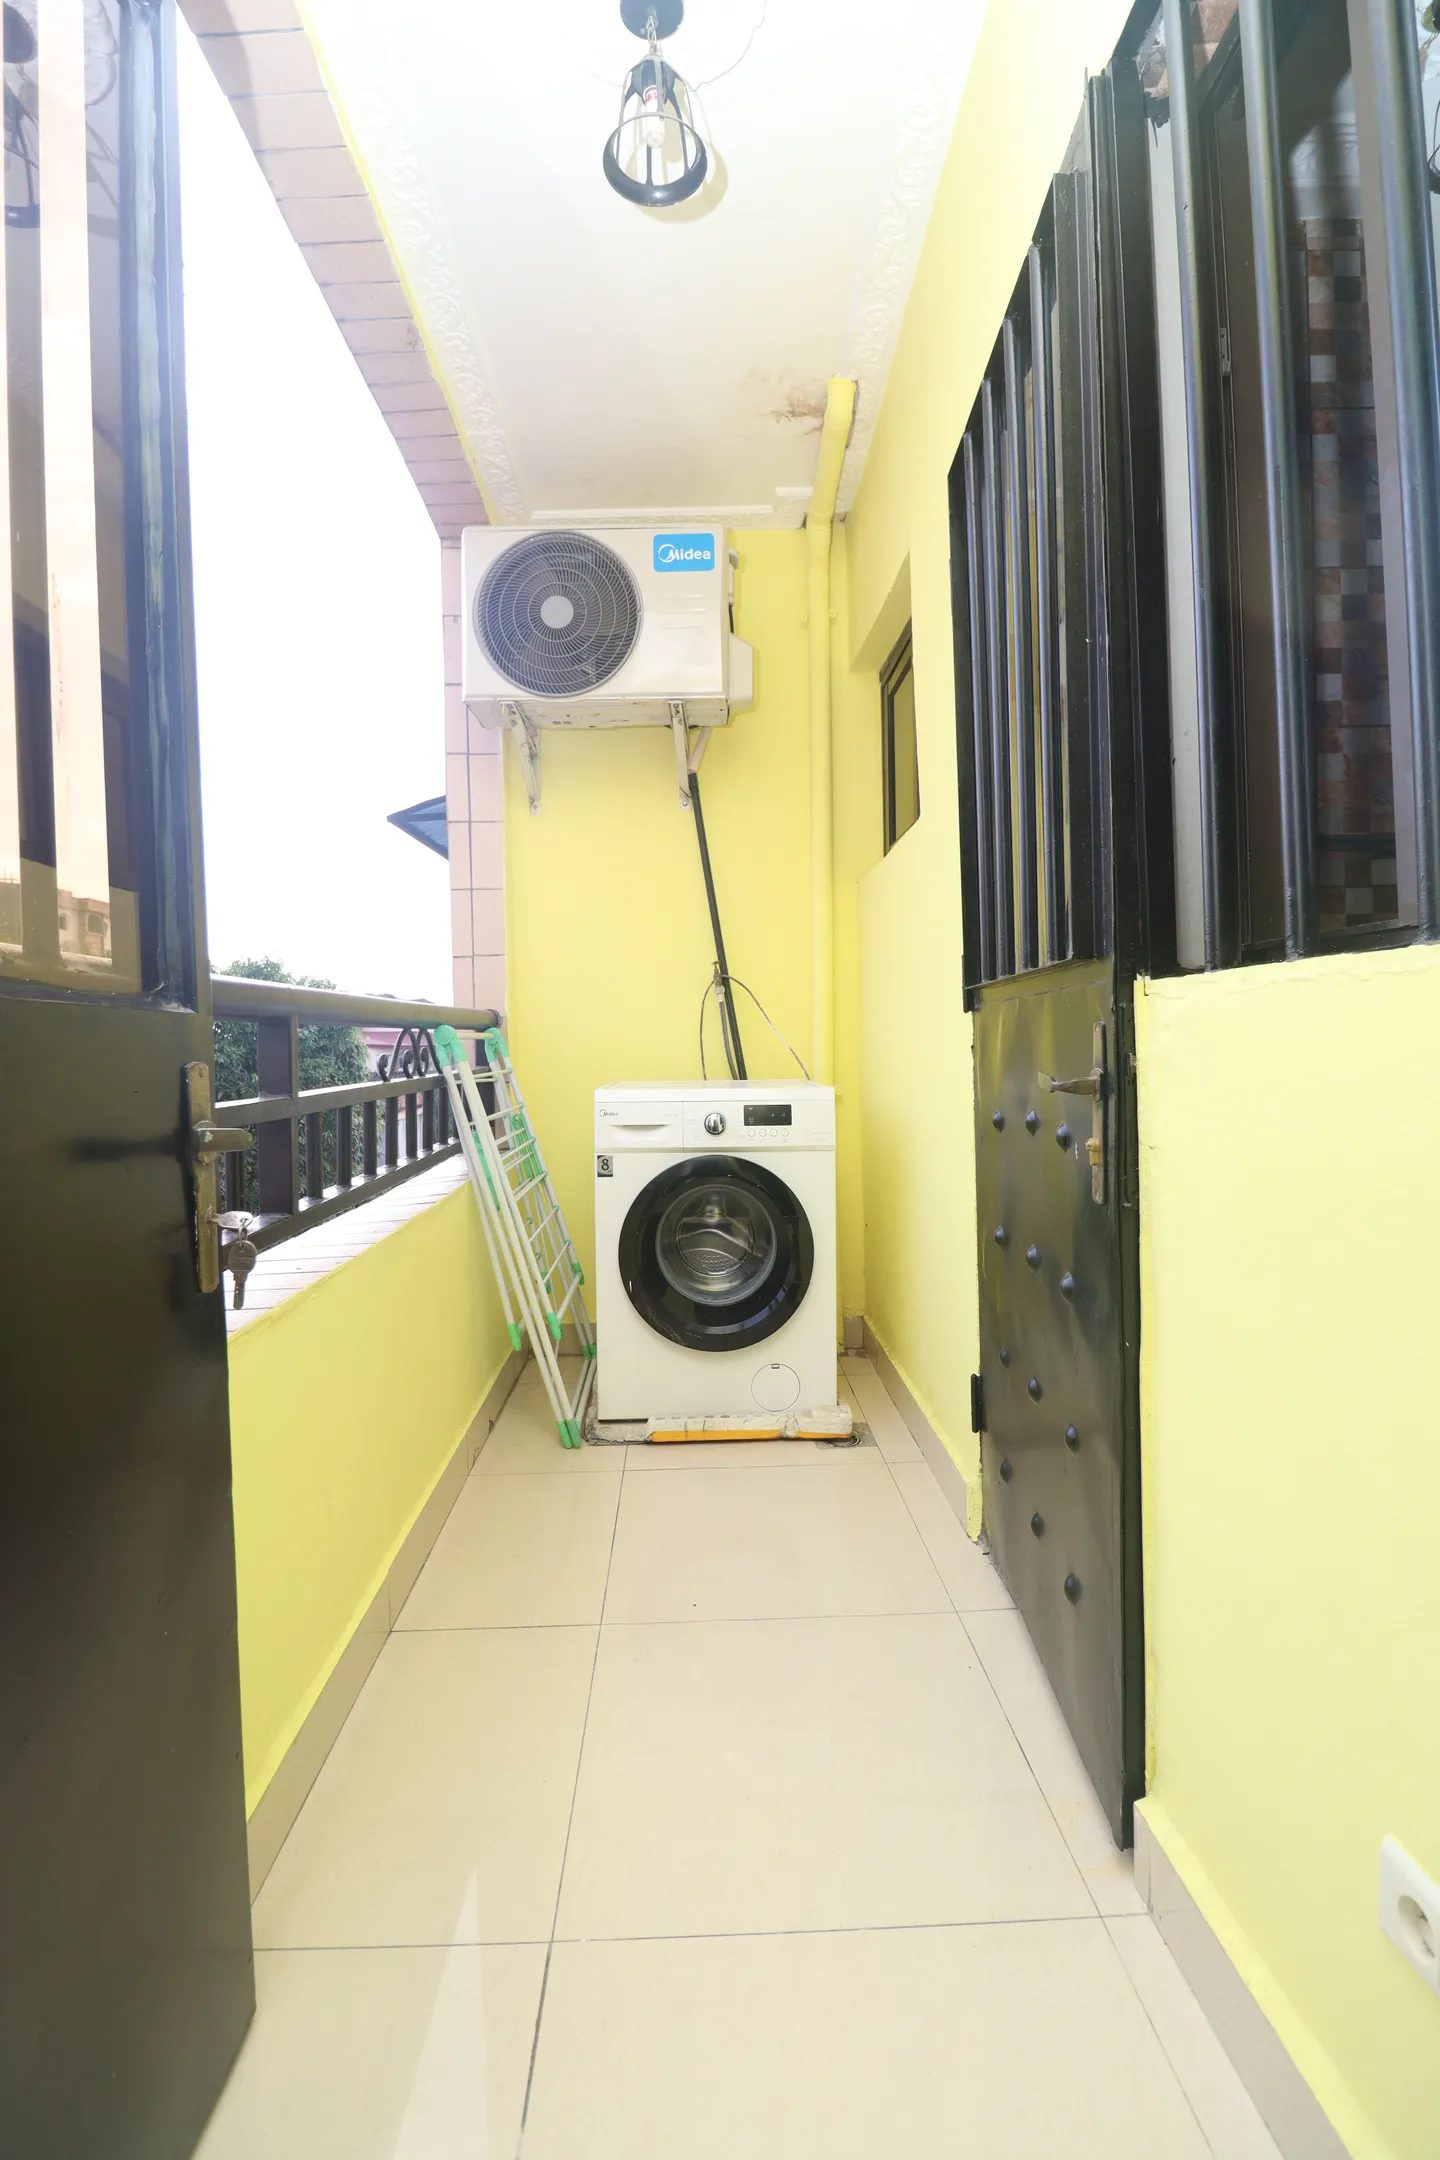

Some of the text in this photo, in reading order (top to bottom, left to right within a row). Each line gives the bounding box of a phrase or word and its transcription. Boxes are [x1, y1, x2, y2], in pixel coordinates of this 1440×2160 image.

[658, 543, 711, 563] Midea
[599, 1108, 619, 1118] Midea
[601, 1158, 610, 1171] 8
